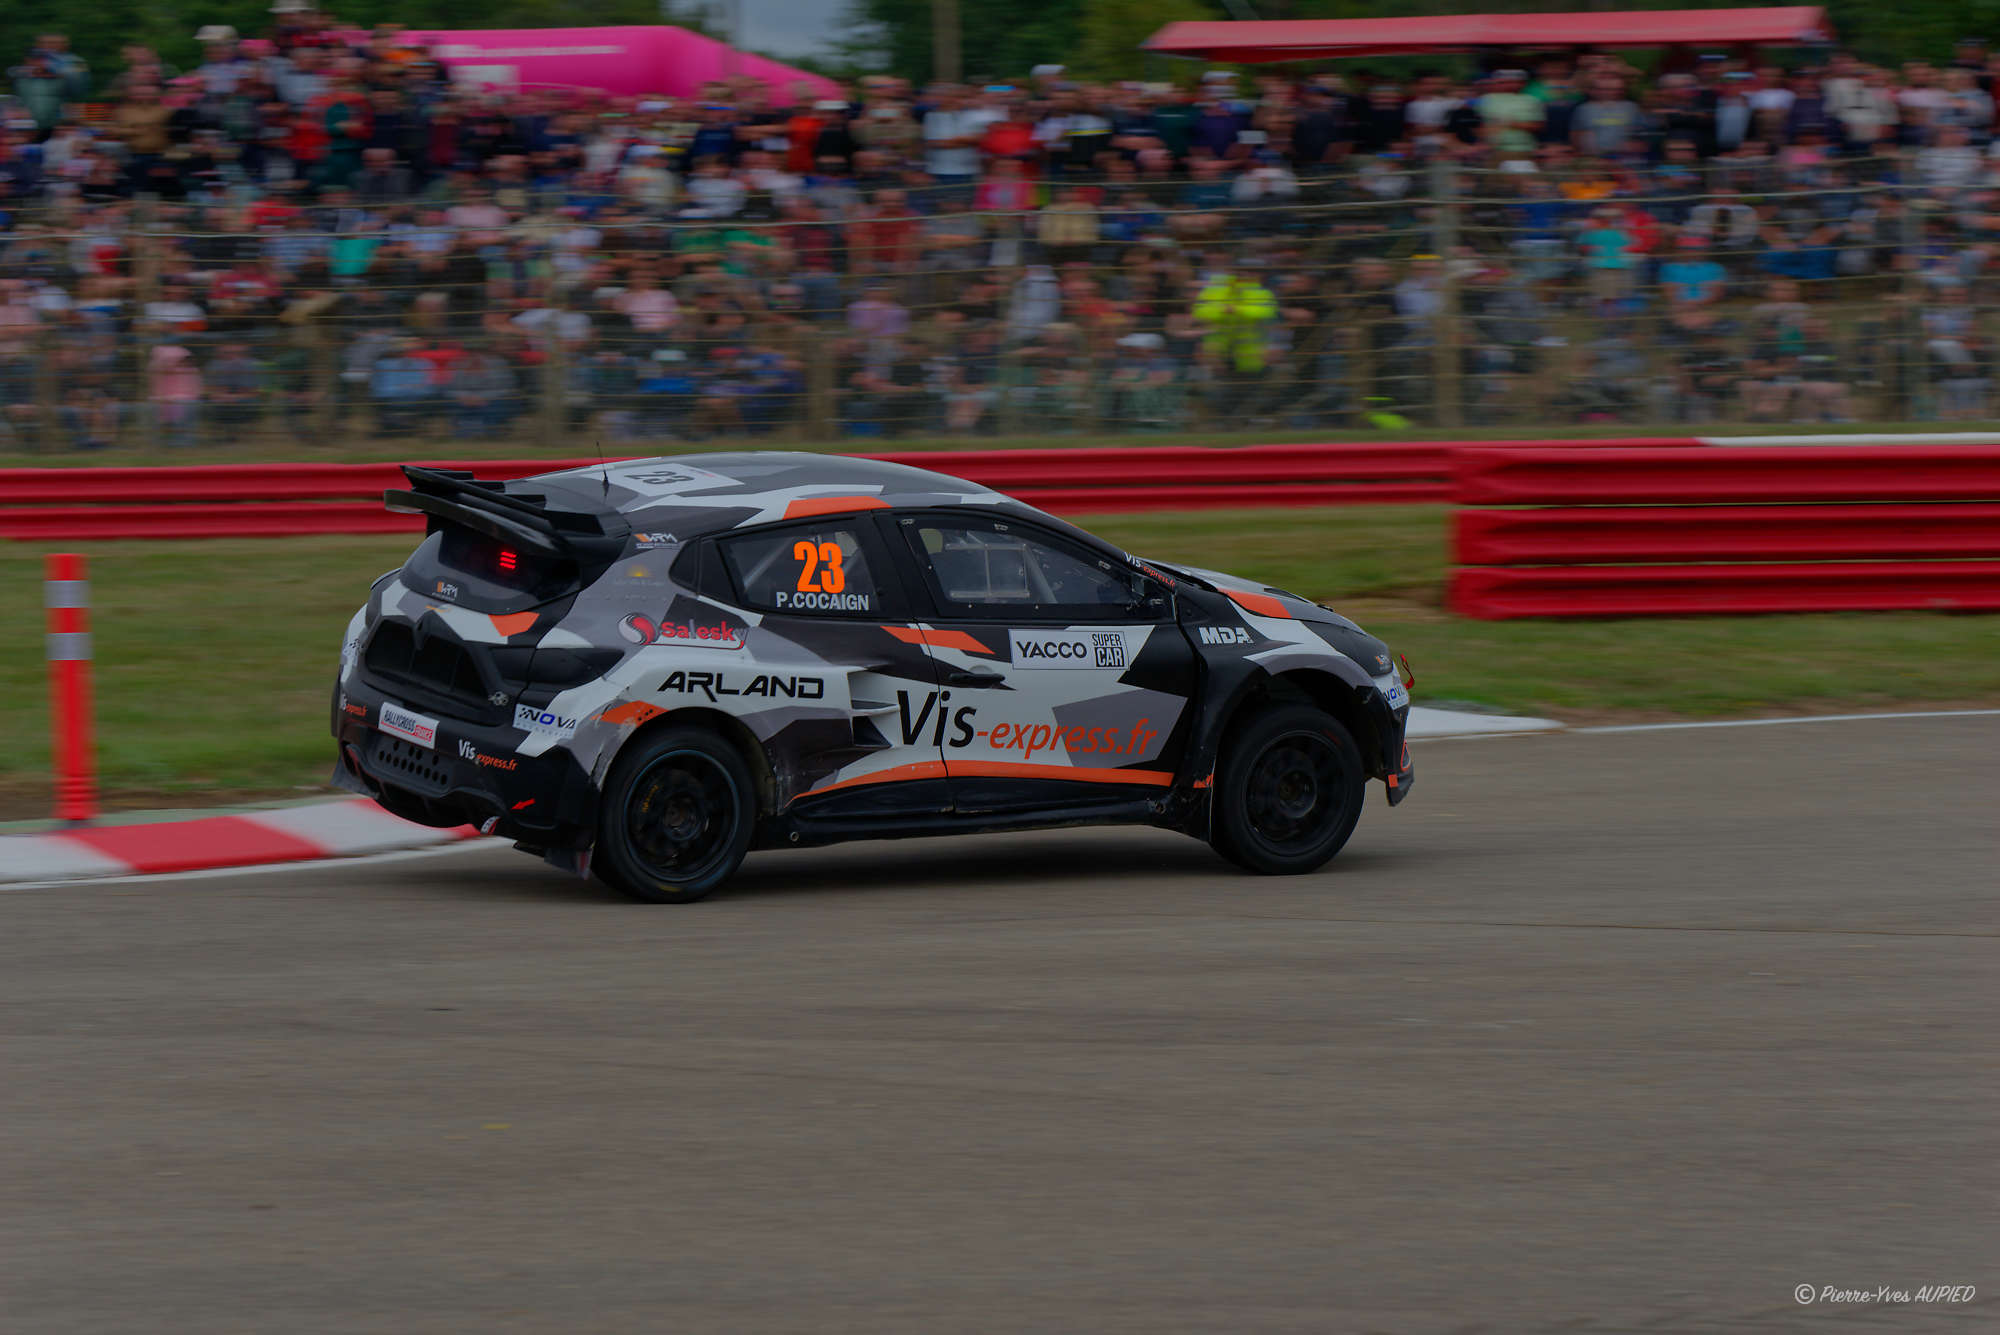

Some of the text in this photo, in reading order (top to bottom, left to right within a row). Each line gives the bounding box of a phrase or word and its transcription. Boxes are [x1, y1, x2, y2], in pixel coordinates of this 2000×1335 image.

[793, 541, 845, 593] 23
[776, 591, 869, 611] P.COCAIGN
[1091, 633, 1121, 647] SUPER
[1199, 626, 1254, 644] MDA
[1016, 641, 1087, 658] YACCO
[1095, 647, 1125, 667] CAR
[657, 671, 824, 702] ARLAND
[521, 708, 576, 729] NOVA
[897, 690, 1158, 760] Vis-express.fr
